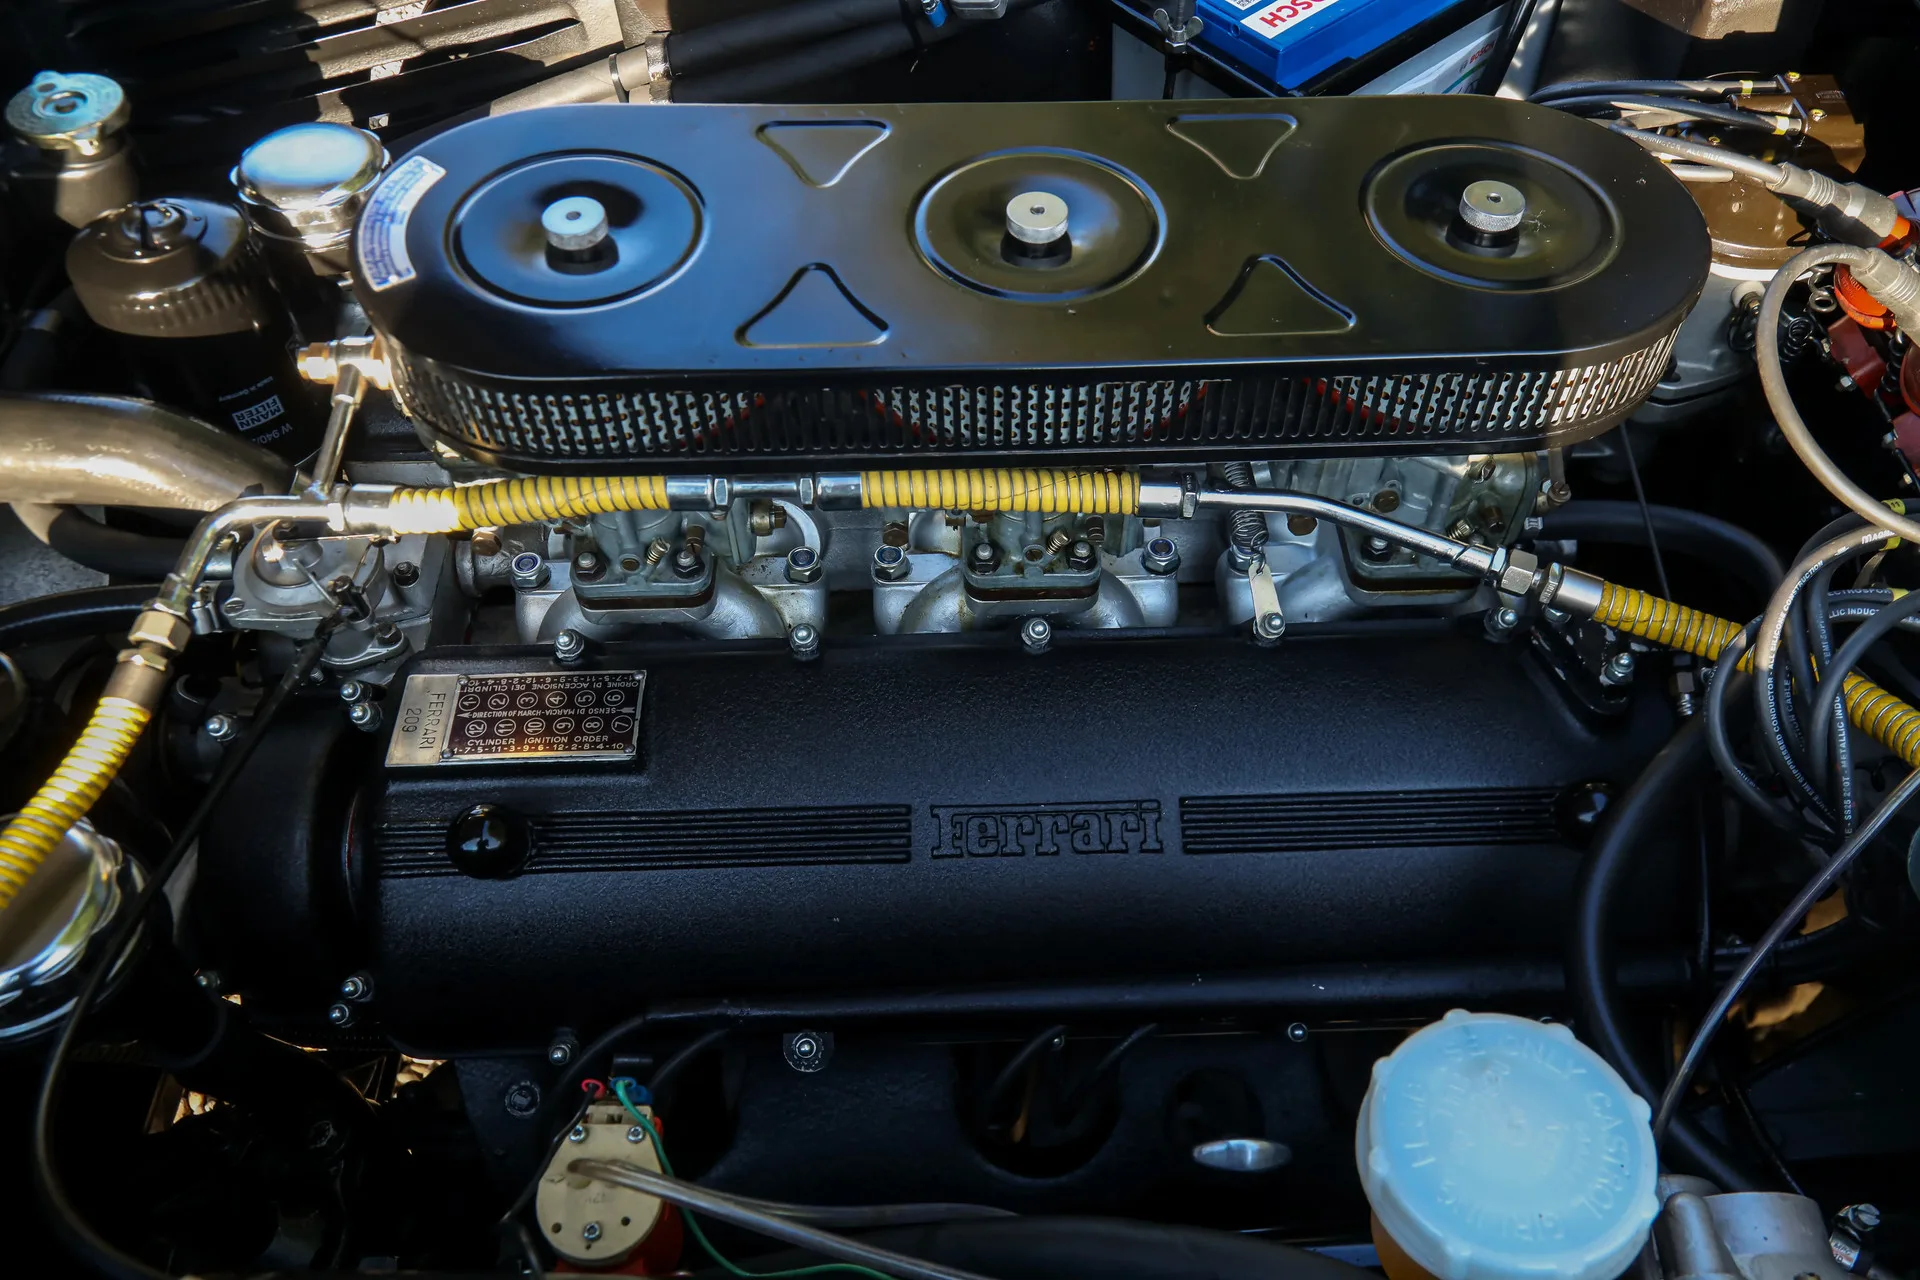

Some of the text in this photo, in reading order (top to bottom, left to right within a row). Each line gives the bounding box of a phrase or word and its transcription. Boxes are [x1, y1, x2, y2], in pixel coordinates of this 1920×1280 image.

[1259, 0, 1324, 28] SCH
[235, 398, 278, 421] FILTER
[239, 406, 281, 429] MANN
[1769, 612, 1787, 651] SILICONE
[1783, 560, 1824, 612] CONSTRUCTION
[1848, 608, 1879, 616] INDUC
[531, 682, 589, 690] ACCENSIONE
[605, 681, 639, 689] ORDINE
[588, 707, 616, 715] SENSO
[1767, 677, 1780, 732] CONDUCTOR
[401, 708, 422, 733] 209
[419, 691, 446, 750] FERRARI
[467, 735, 609, 746] CYLINDER IGNITION ORDER
[1776, 734, 1805, 783] SUPPRESSED
[930, 799, 1164, 859] Ferrari
[1586, 1091, 1631, 1220] CASTROL
